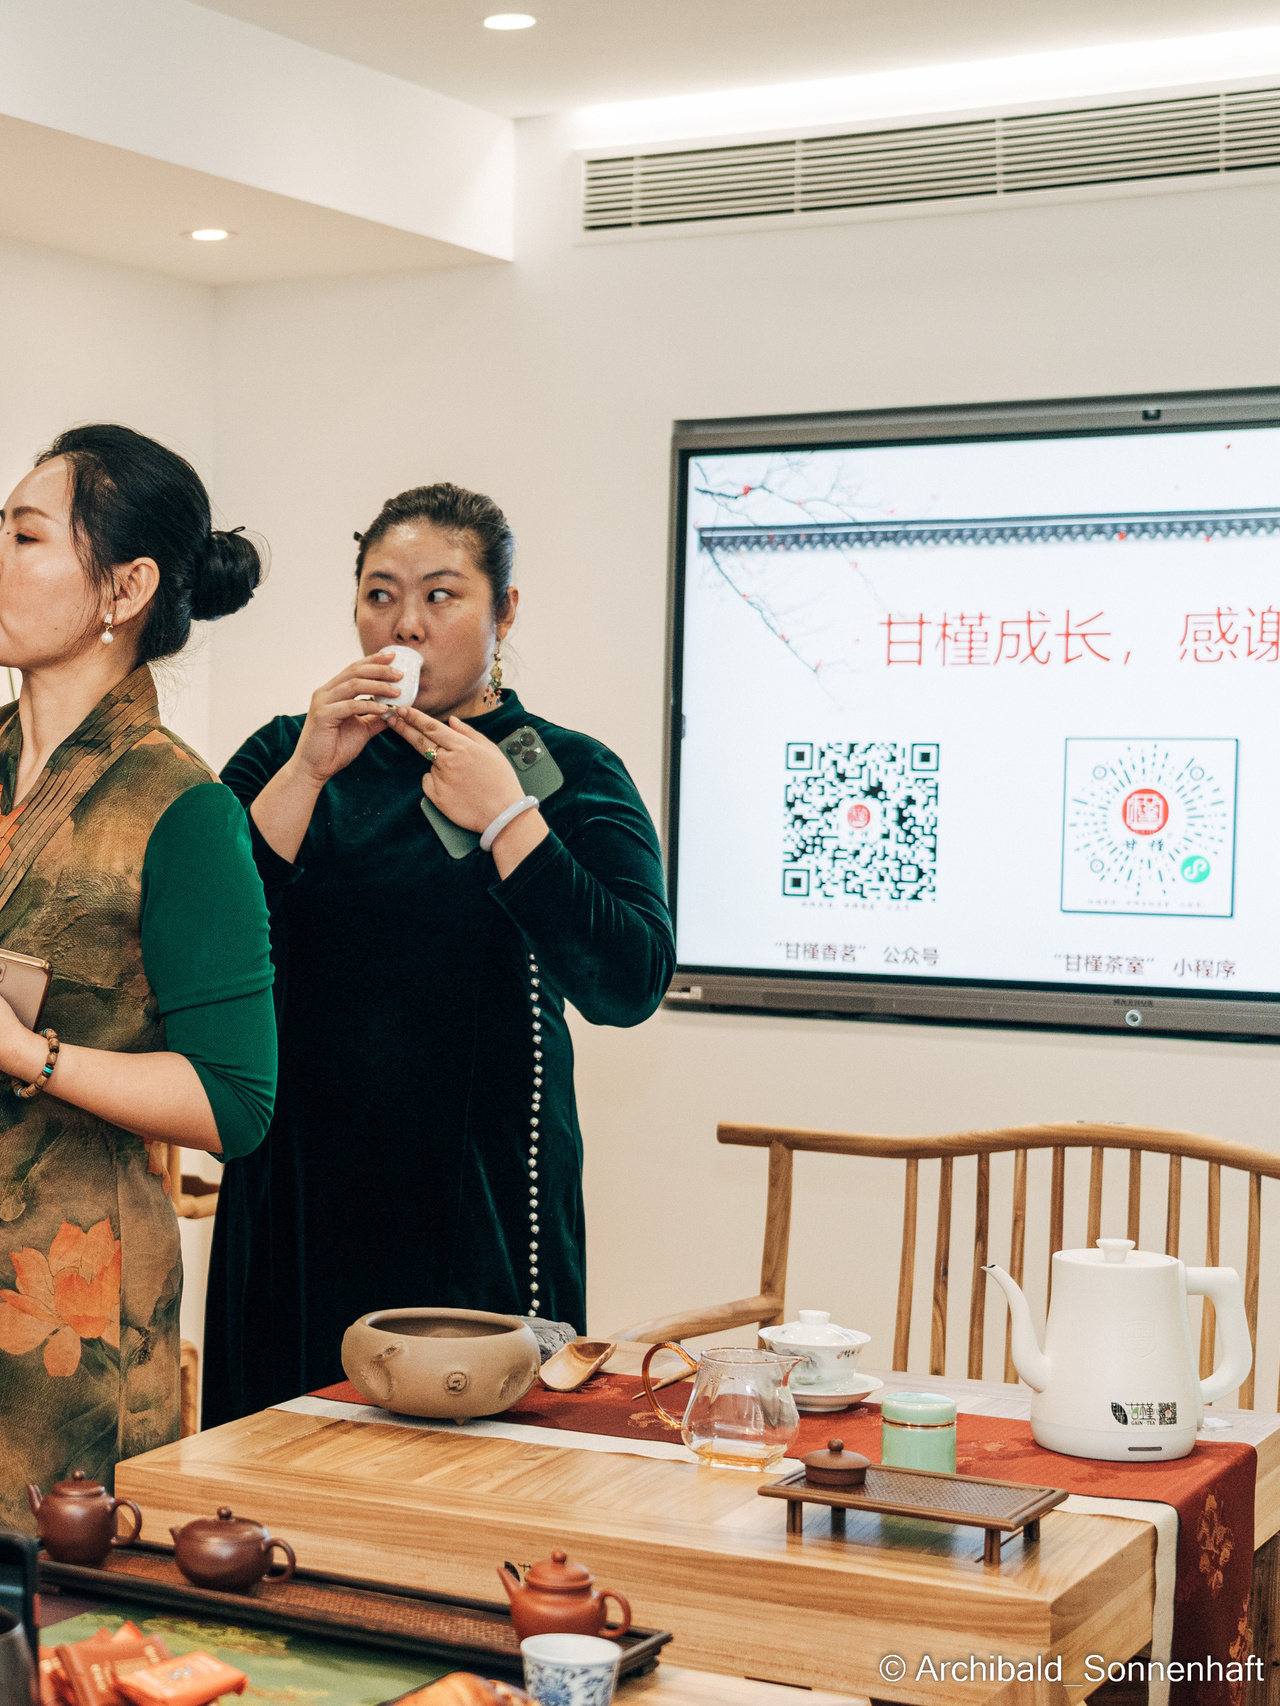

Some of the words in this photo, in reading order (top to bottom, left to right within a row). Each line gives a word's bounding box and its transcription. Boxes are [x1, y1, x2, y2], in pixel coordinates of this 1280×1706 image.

[883, 946, 939, 966] 公众号
[1173, 957, 1236, 978] 小程序
